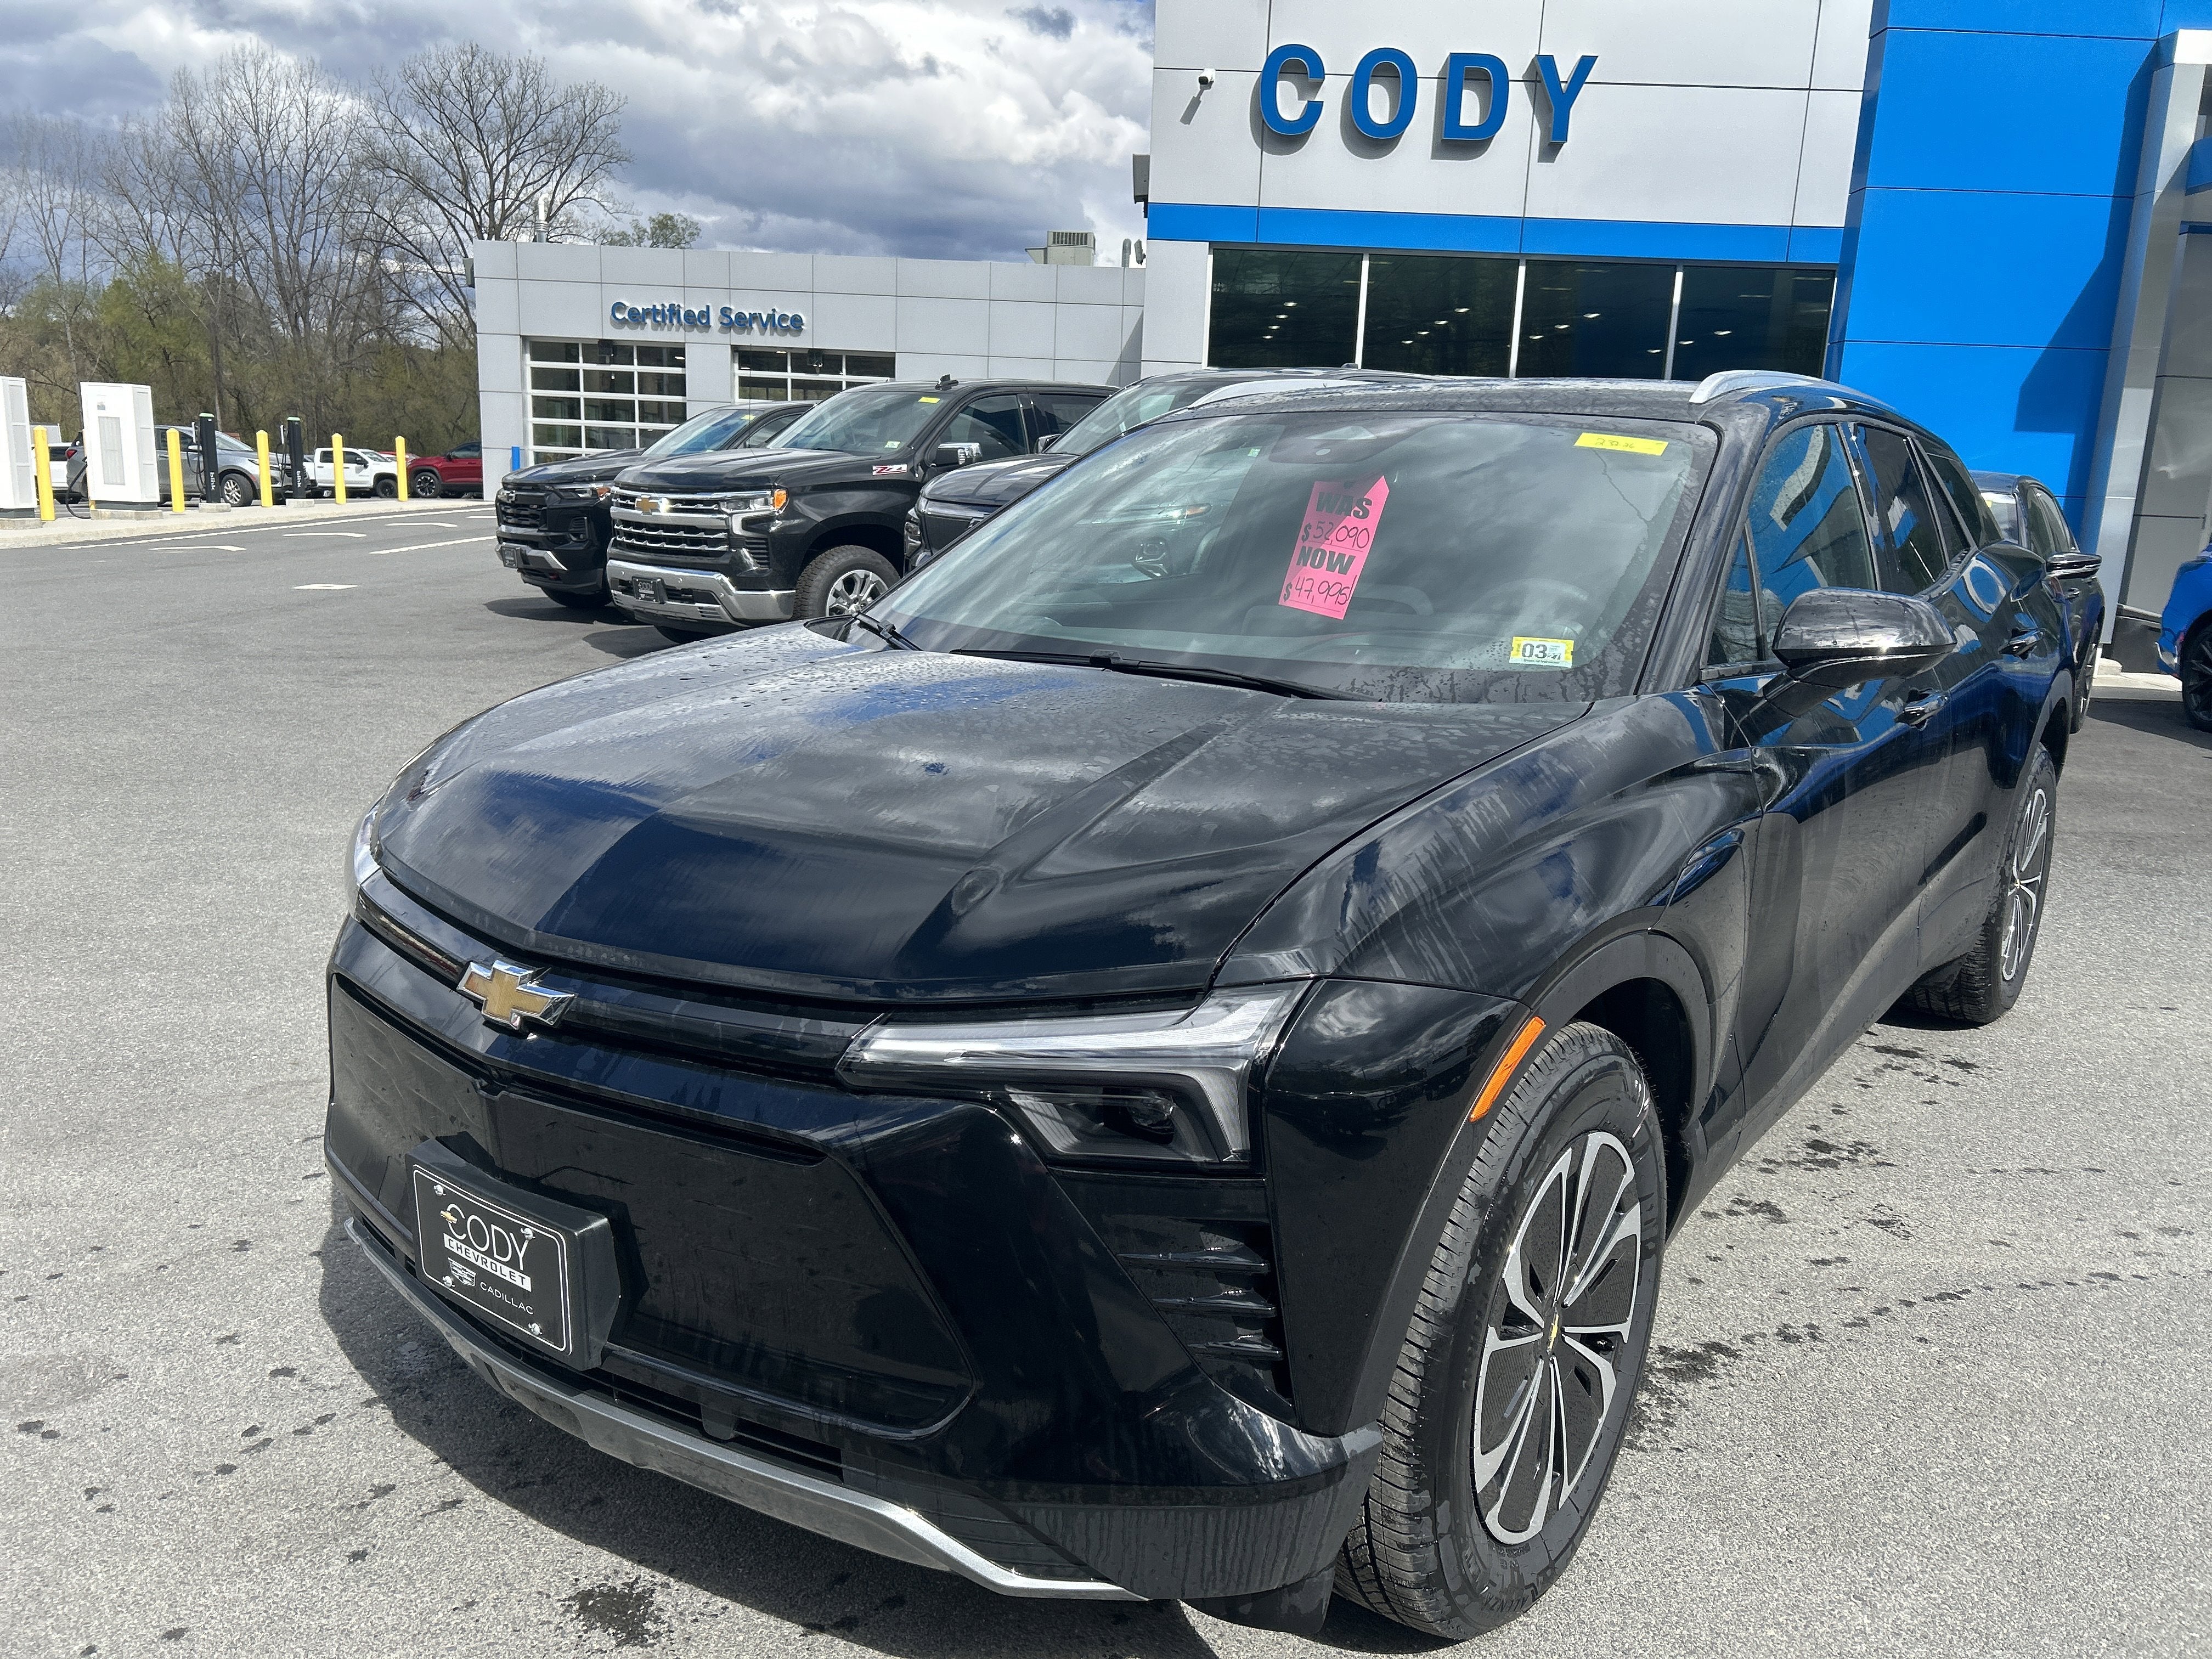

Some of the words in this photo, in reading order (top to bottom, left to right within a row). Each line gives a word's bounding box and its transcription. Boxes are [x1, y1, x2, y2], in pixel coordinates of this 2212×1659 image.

[1261, 43, 1599, 144] CODY
[611, 302, 711, 328] Certified
[719, 306, 804, 330] Service
[1316, 492, 1373, 519] WAS
[1296, 546, 1356, 575] NOW
[1522, 643, 1548, 659] 03
[445, 1203, 529, 1271] CODY
[448, 1238, 527, 1286] CHEVROLET
[480, 1282, 534, 1315] CADILLAC
